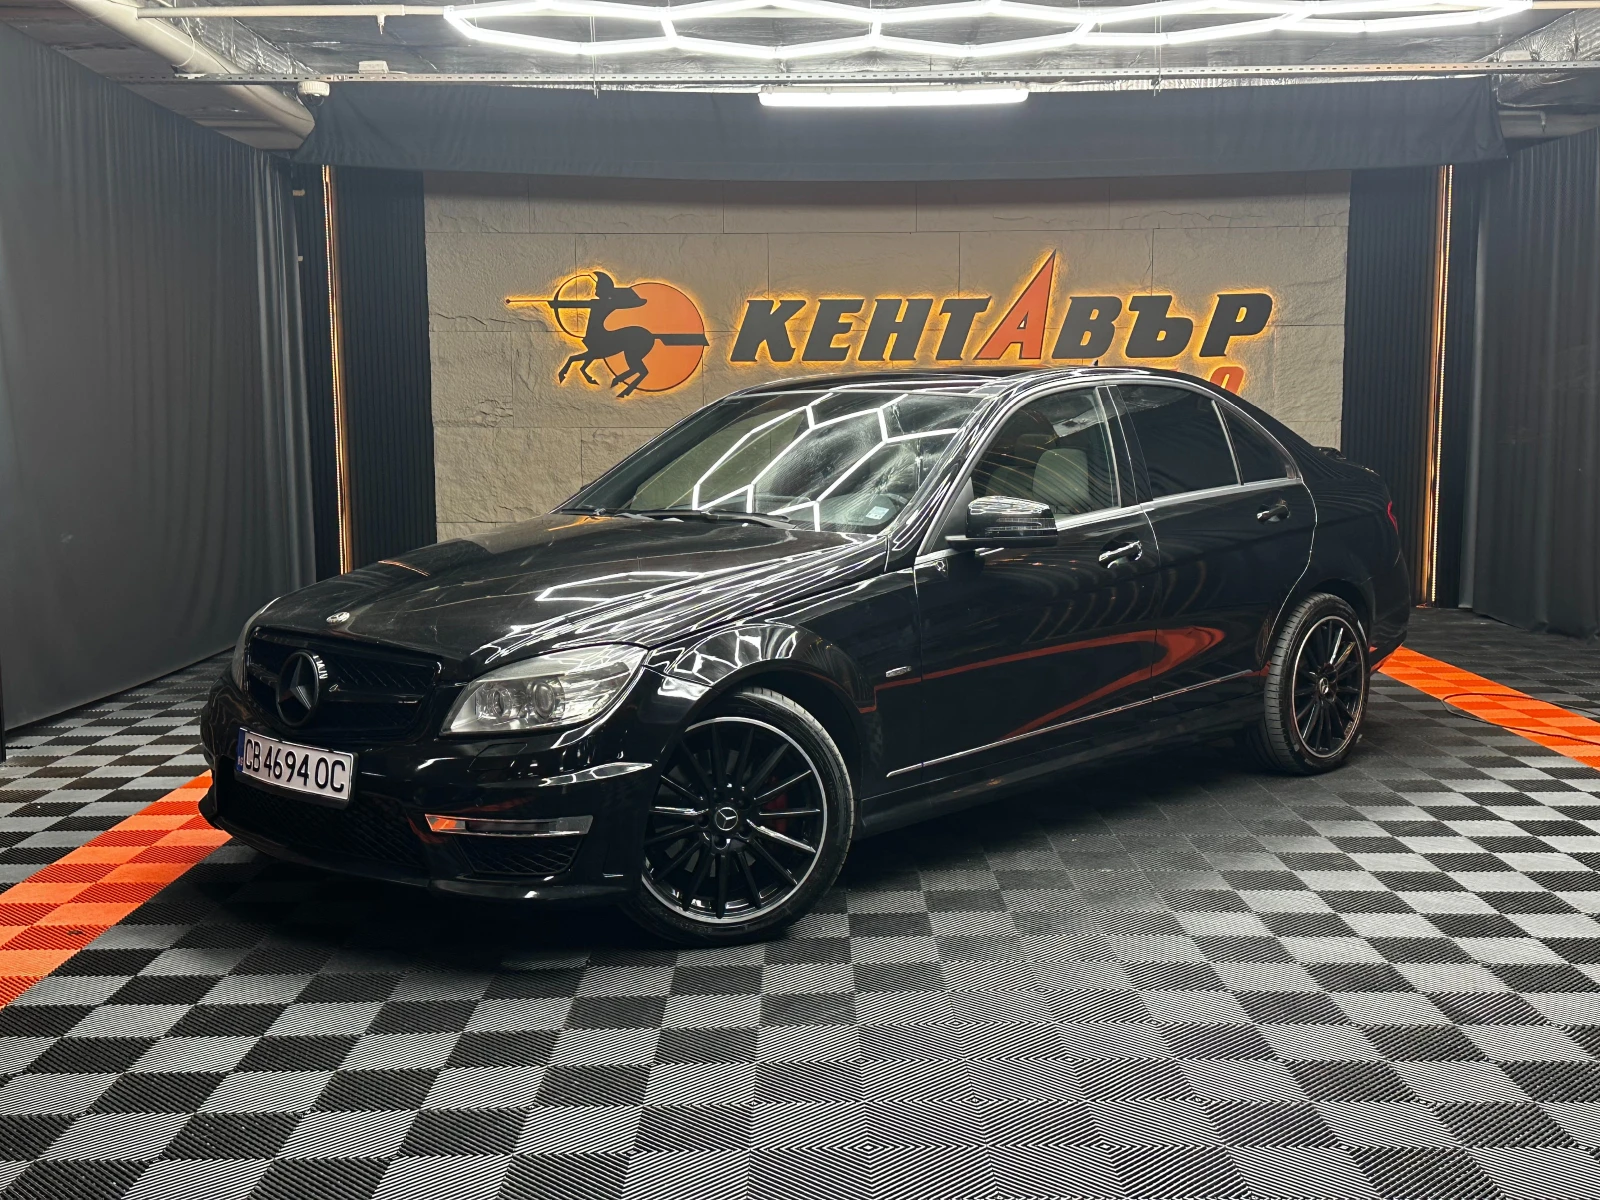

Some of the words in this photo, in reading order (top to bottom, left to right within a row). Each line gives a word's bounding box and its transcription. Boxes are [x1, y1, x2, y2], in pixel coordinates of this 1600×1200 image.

[730, 249, 1273, 362] КЕНТАВЪР
[245, 739, 261, 772] CB
[264, 745, 310, 786] 4694
